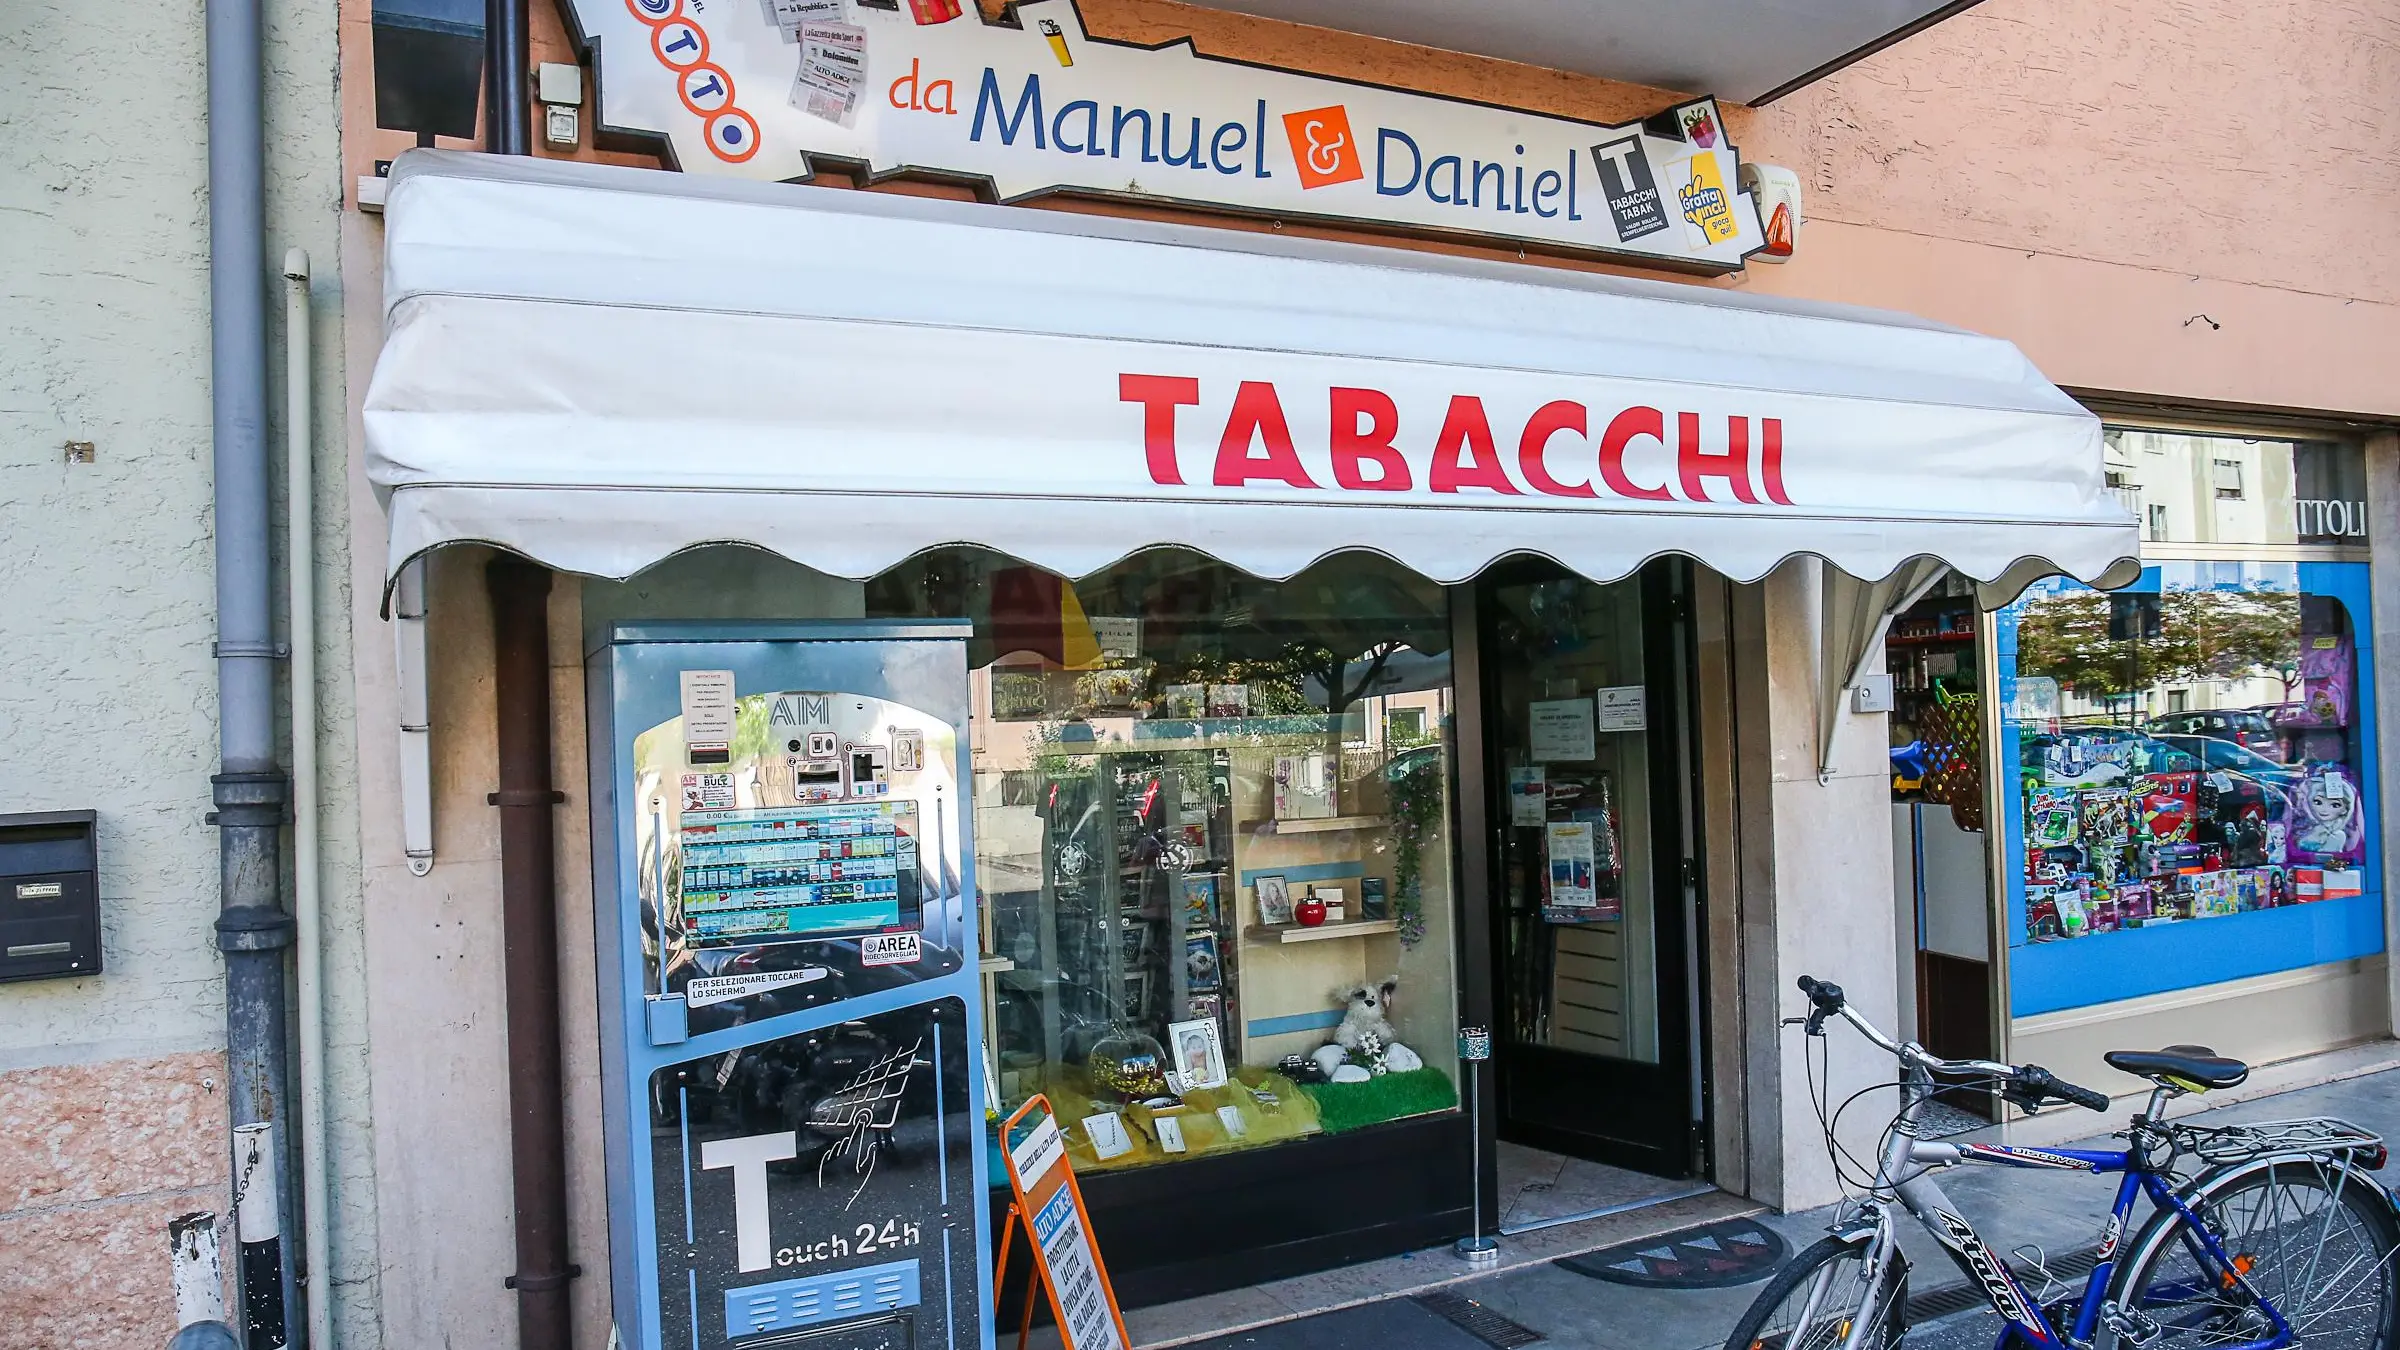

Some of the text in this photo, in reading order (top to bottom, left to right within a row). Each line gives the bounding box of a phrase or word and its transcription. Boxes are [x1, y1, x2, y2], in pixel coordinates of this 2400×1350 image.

[814, 64, 831, 76] ALTO
[888, 57, 957, 115] da
[970, 66, 1272, 179] Manuel
[1375, 126, 1582, 222] Daniel
[1598, 139, 1636, 194] T
[1610, 187, 1658, 211] TABACCHI
[1682, 189, 1718, 211] Gratta
[1620, 201, 1655, 221] TABAK
[1711, 216, 1730, 230] gioca
[1118, 372, 1800, 507] TABACCHI
[769, 695, 830, 726] AM
[706, 812, 722, 820] 0.00
[864, 950, 919, 961] VIDEOSORVEGLIATA
[878, 936, 917, 953] AREA
[692, 971, 805, 989] PER SELEZIONARE TOCCARE
[692, 986, 746, 999] LO SCHERMO
[1035, 1188, 1074, 1242] ALTO ADIGE
[1046, 1219, 1079, 1272] PROSTITUZIONE
[1932, 1205, 2028, 1321] Atala
[1060, 1266, 1070, 1287] LA
[1073, 1312, 1086, 1337] DAL
[1080, 1290, 1098, 1323] RACKET
